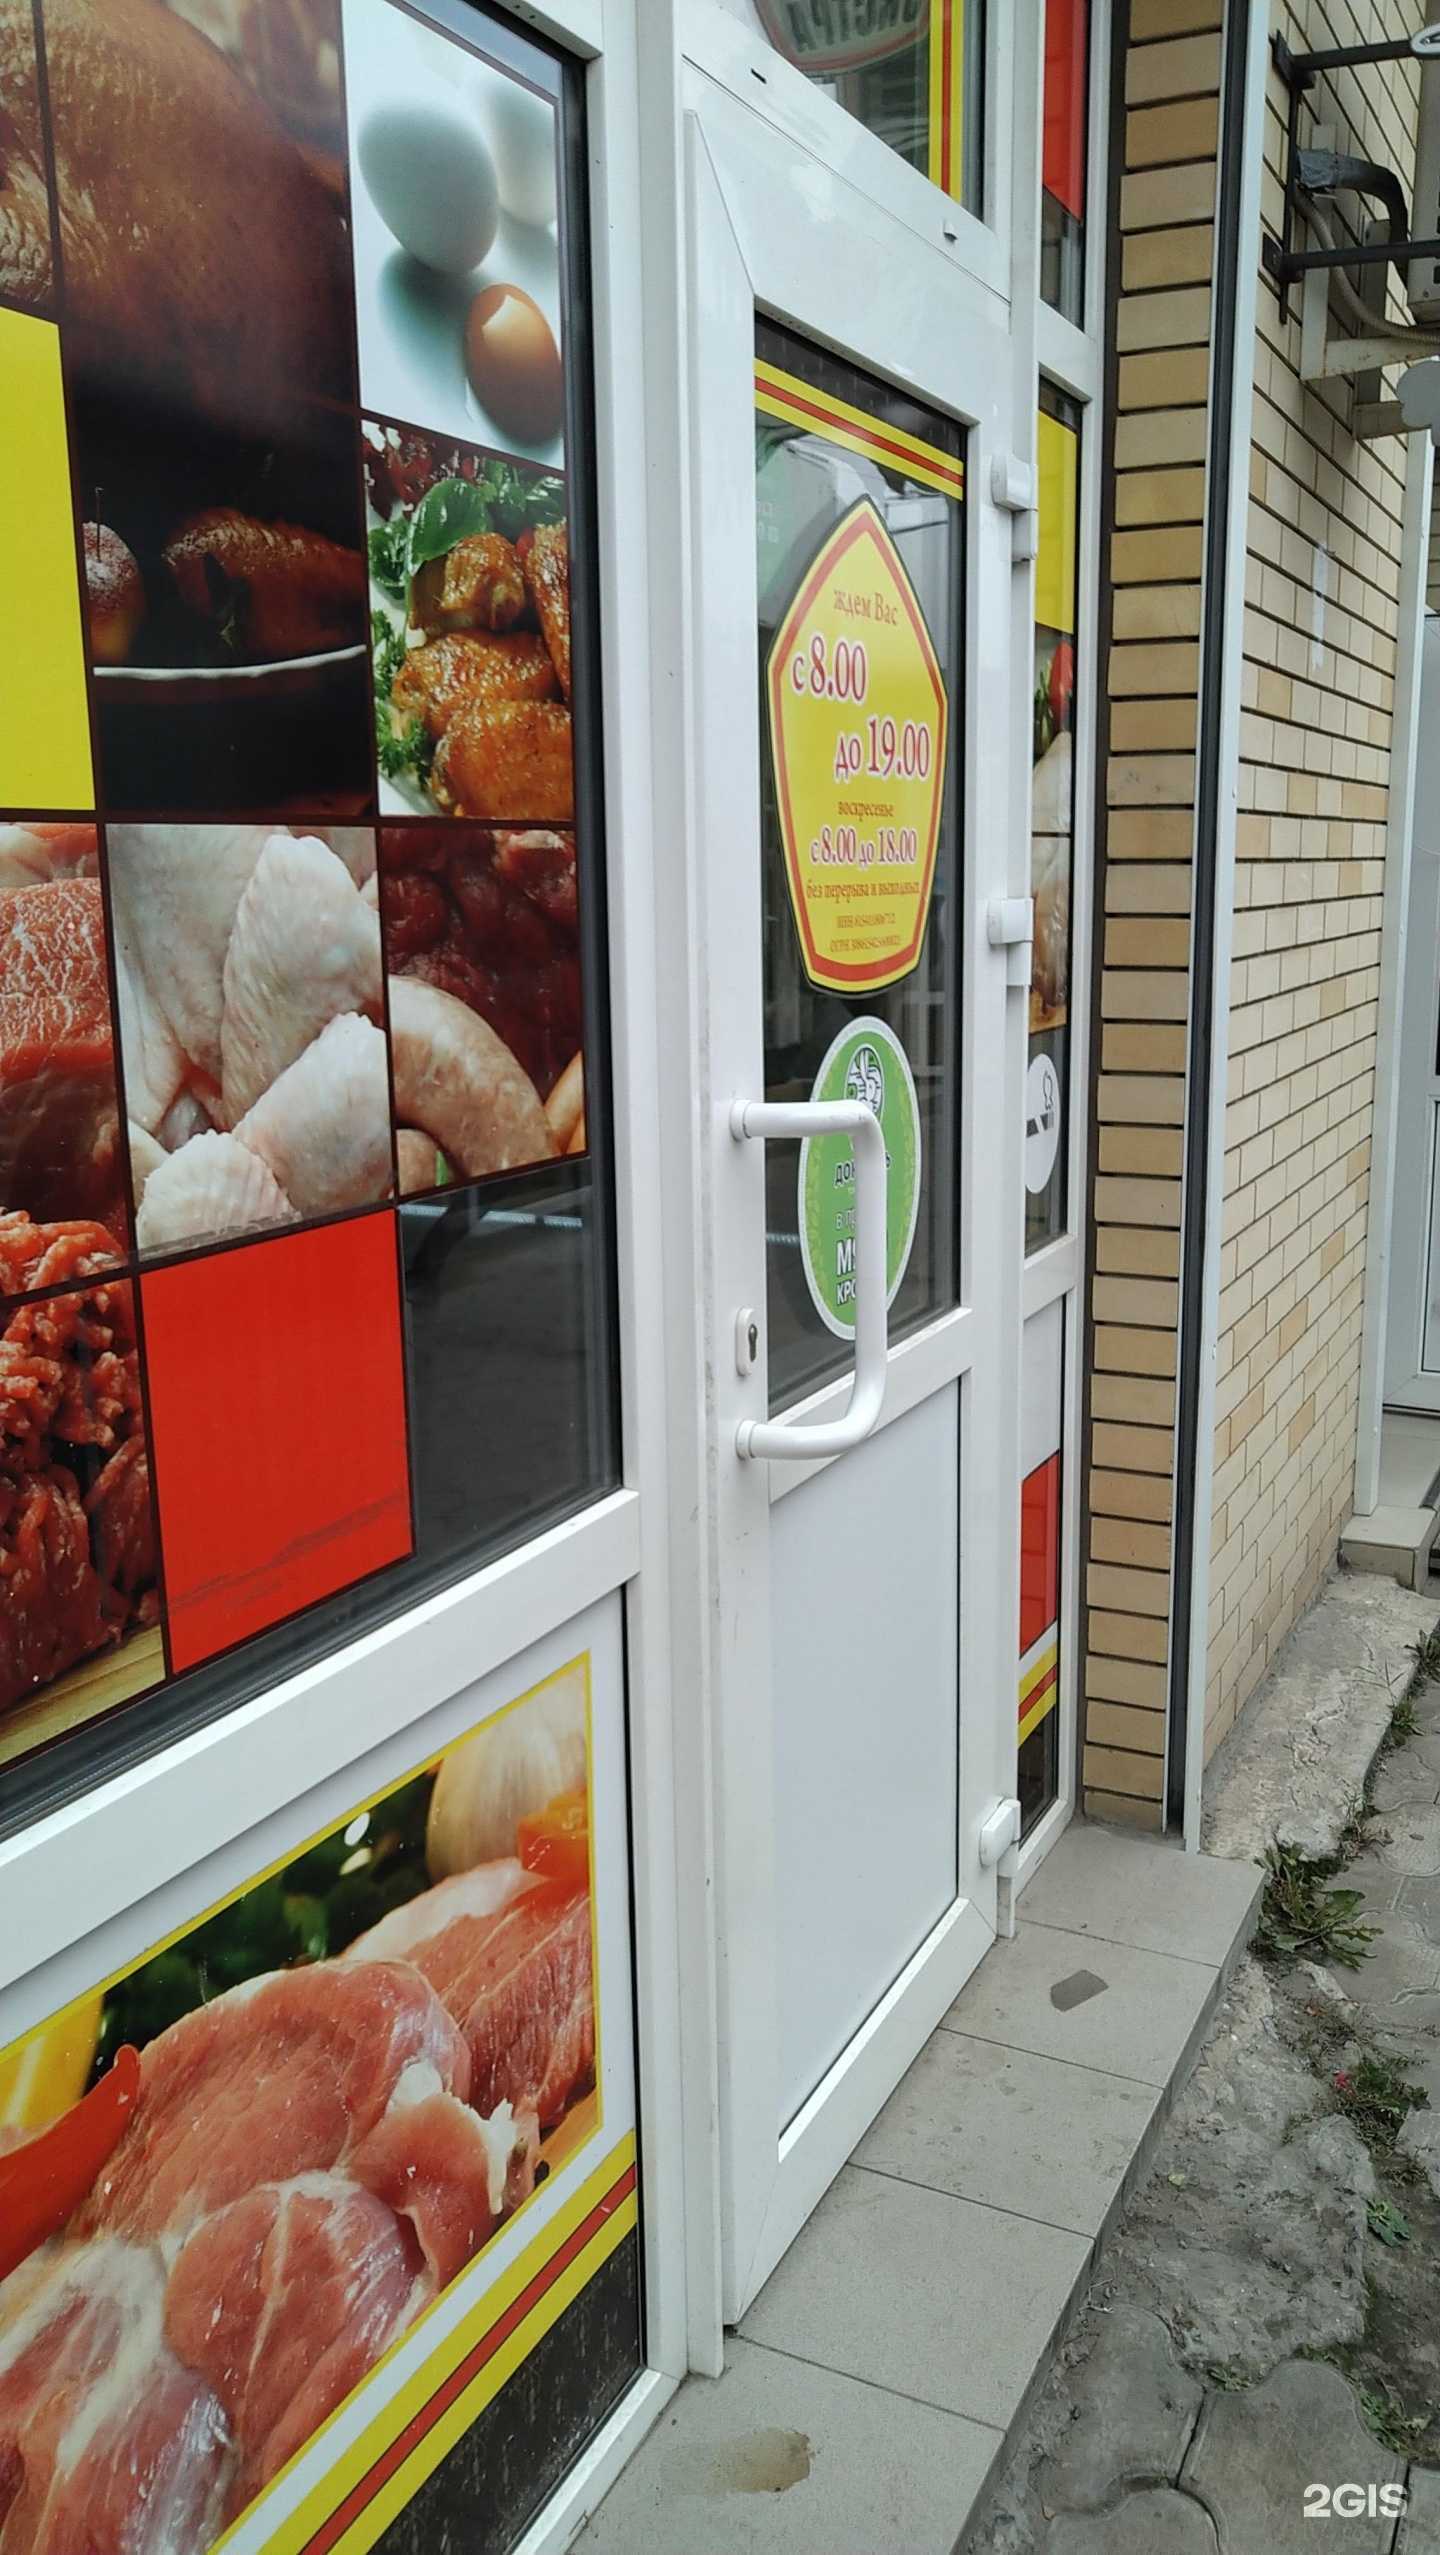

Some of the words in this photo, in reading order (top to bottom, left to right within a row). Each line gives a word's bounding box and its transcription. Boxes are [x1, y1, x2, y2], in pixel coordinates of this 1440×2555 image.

[833, 589, 871, 620] ждем
[875, 592, 898, 626] Вас
[810, 635, 867, 702] 8.00
[835, 735, 862, 780] до
[867, 718, 930, 778] 19.00
[837, 801, 895, 822] воскресенье
[821, 826, 857, 864] 8.00
[859, 841, 875, 868] до
[878, 828, 918, 864] 18.00
[806, 878, 823, 899] без
[824, 884, 869, 904] перерыва
